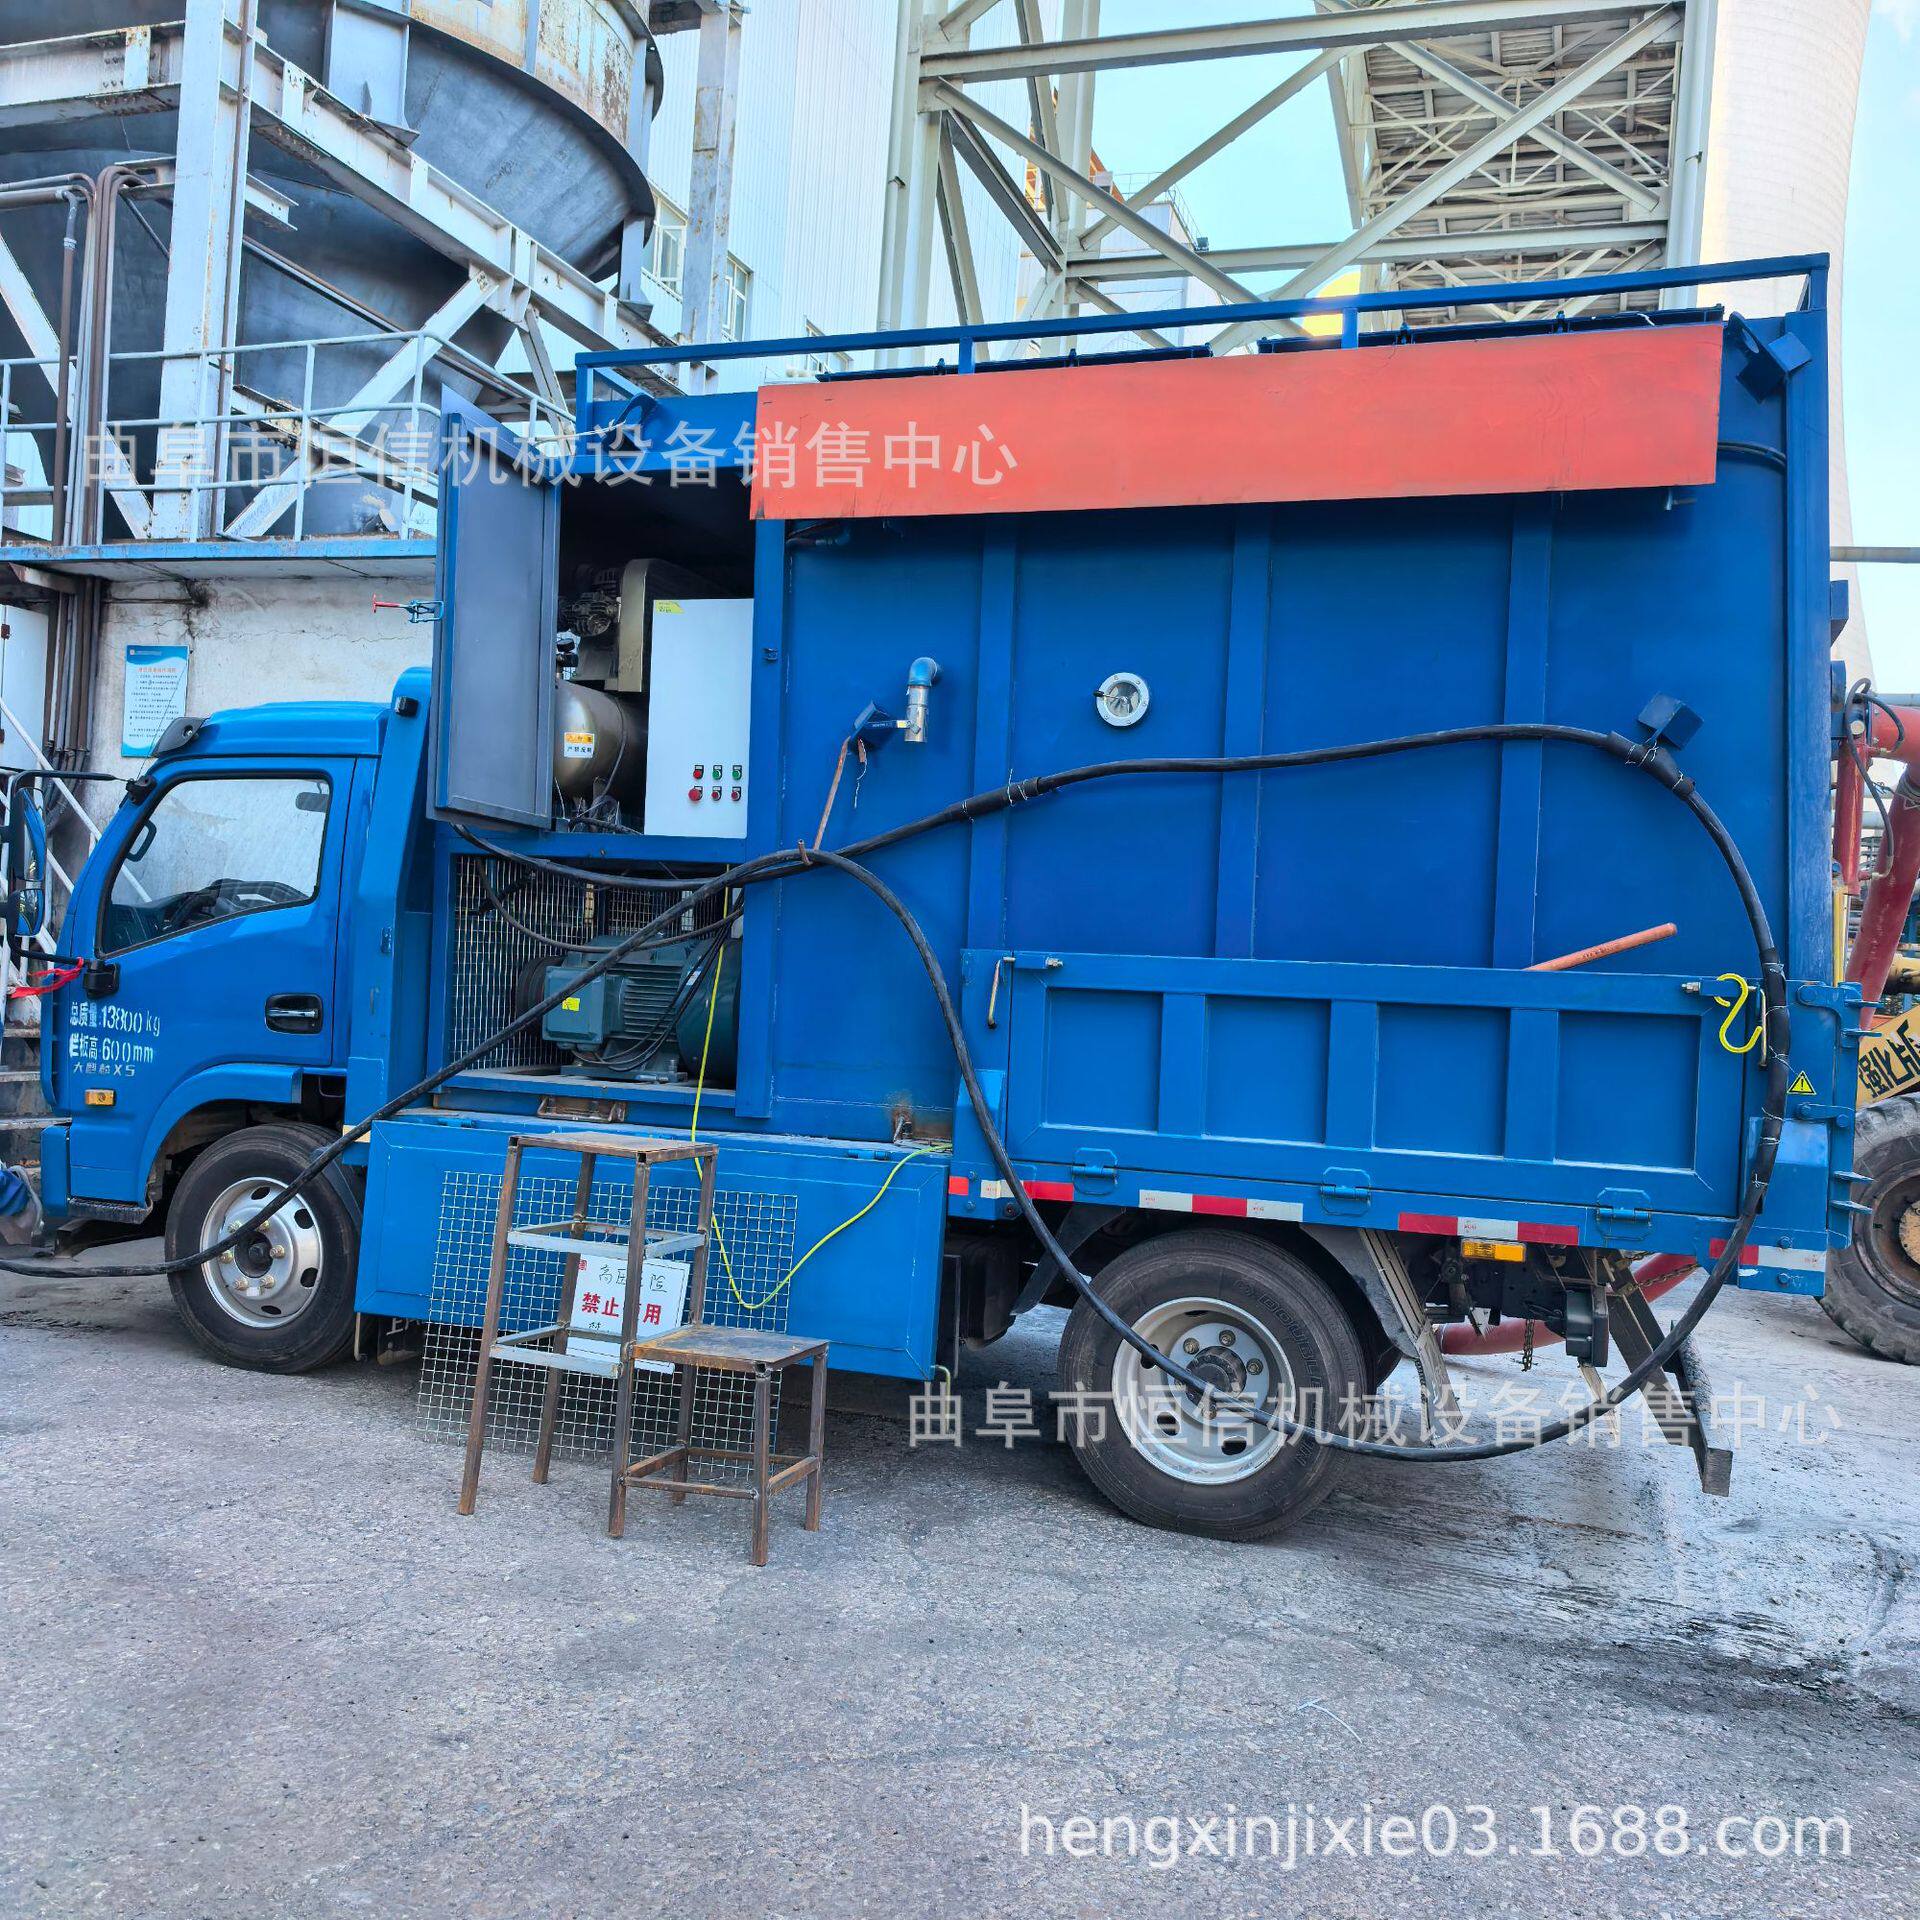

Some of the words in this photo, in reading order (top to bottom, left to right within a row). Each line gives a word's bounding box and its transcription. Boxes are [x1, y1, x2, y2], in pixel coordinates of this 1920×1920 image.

[598, 1263, 668, 1293] 高压险
[581, 1291, 662, 1326] 禁止用
